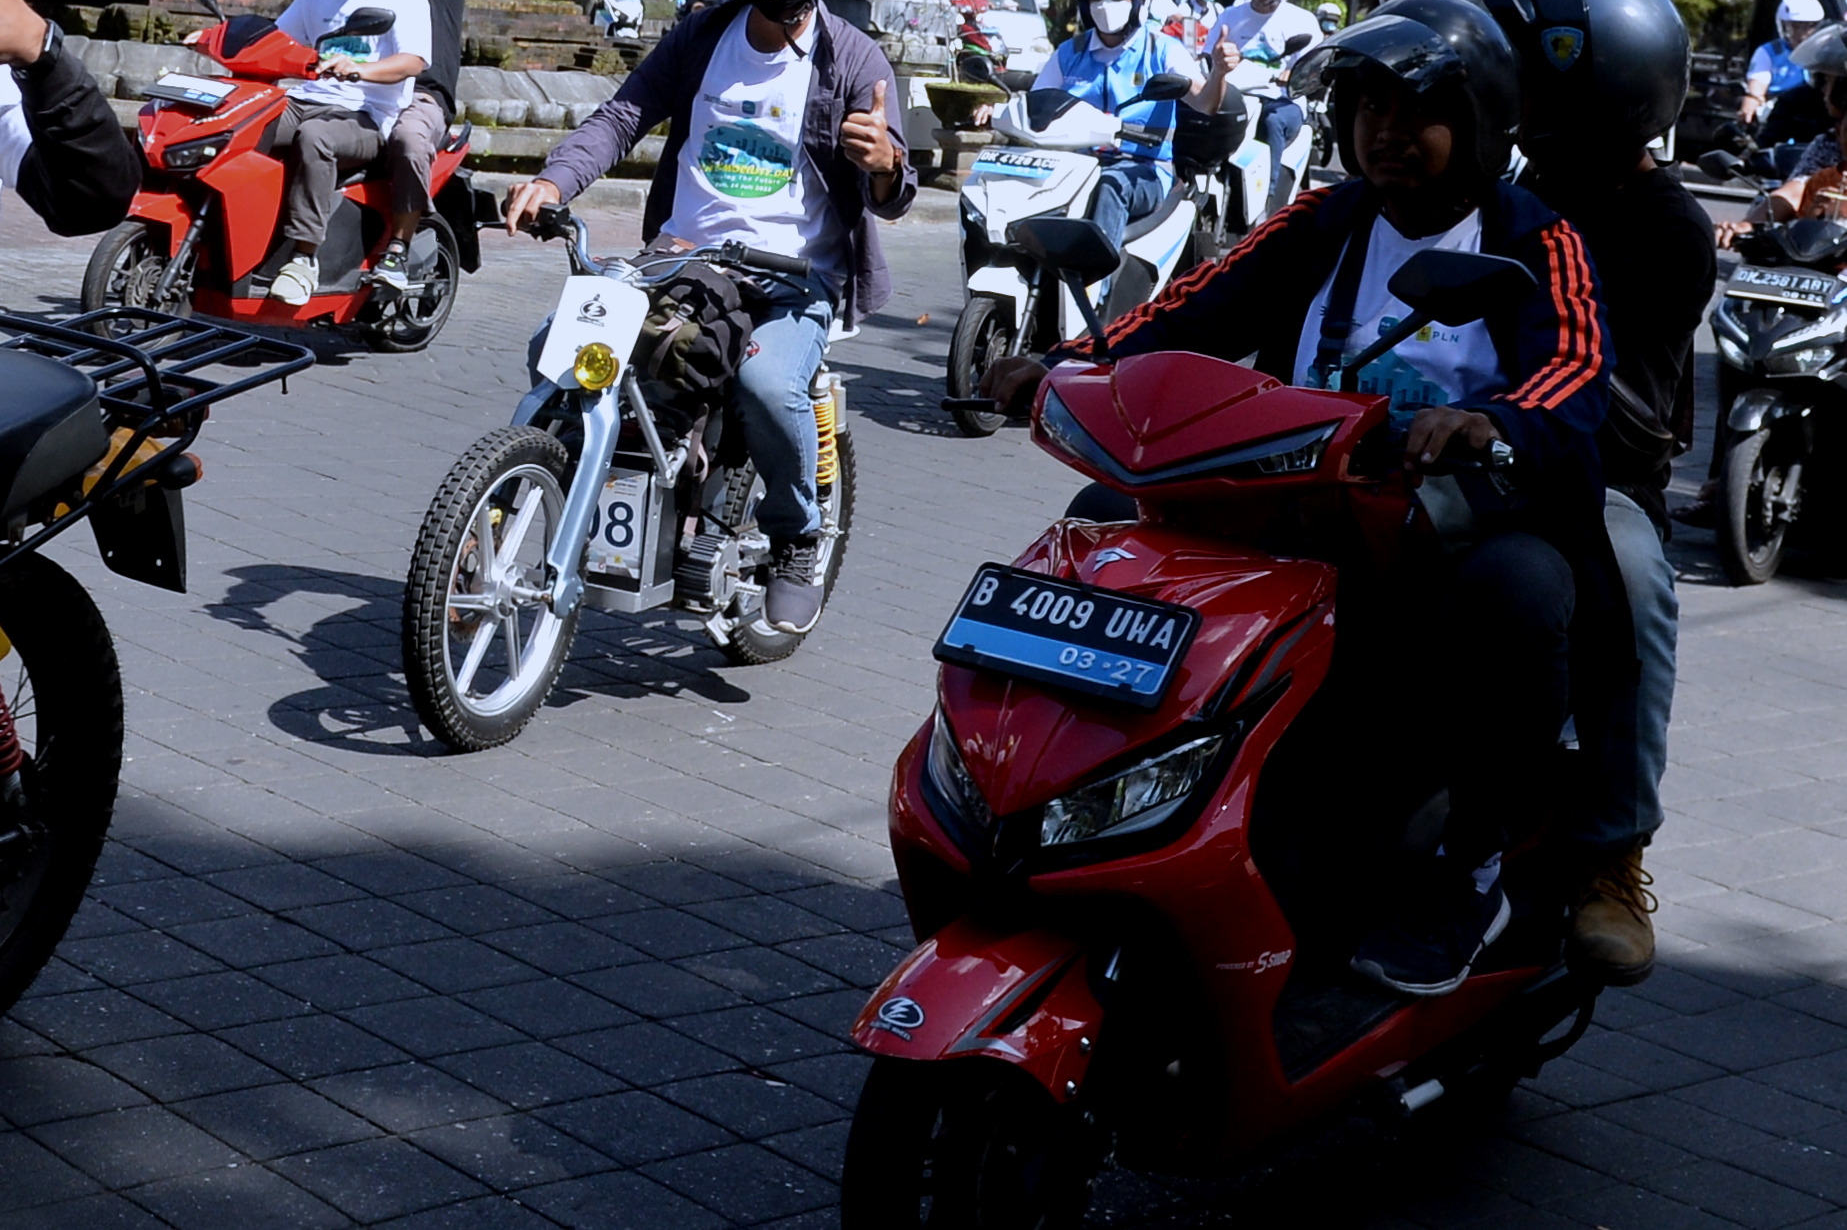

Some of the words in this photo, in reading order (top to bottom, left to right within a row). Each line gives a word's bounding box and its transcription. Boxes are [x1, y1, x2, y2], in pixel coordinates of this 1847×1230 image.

[980, 151, 1000, 162] DK
[1433, 330, 1460, 343] PLN
[972, 577, 999, 606] B
[1010, 586, 1095, 630] 4009
[1104, 607, 1176, 650] UWA
